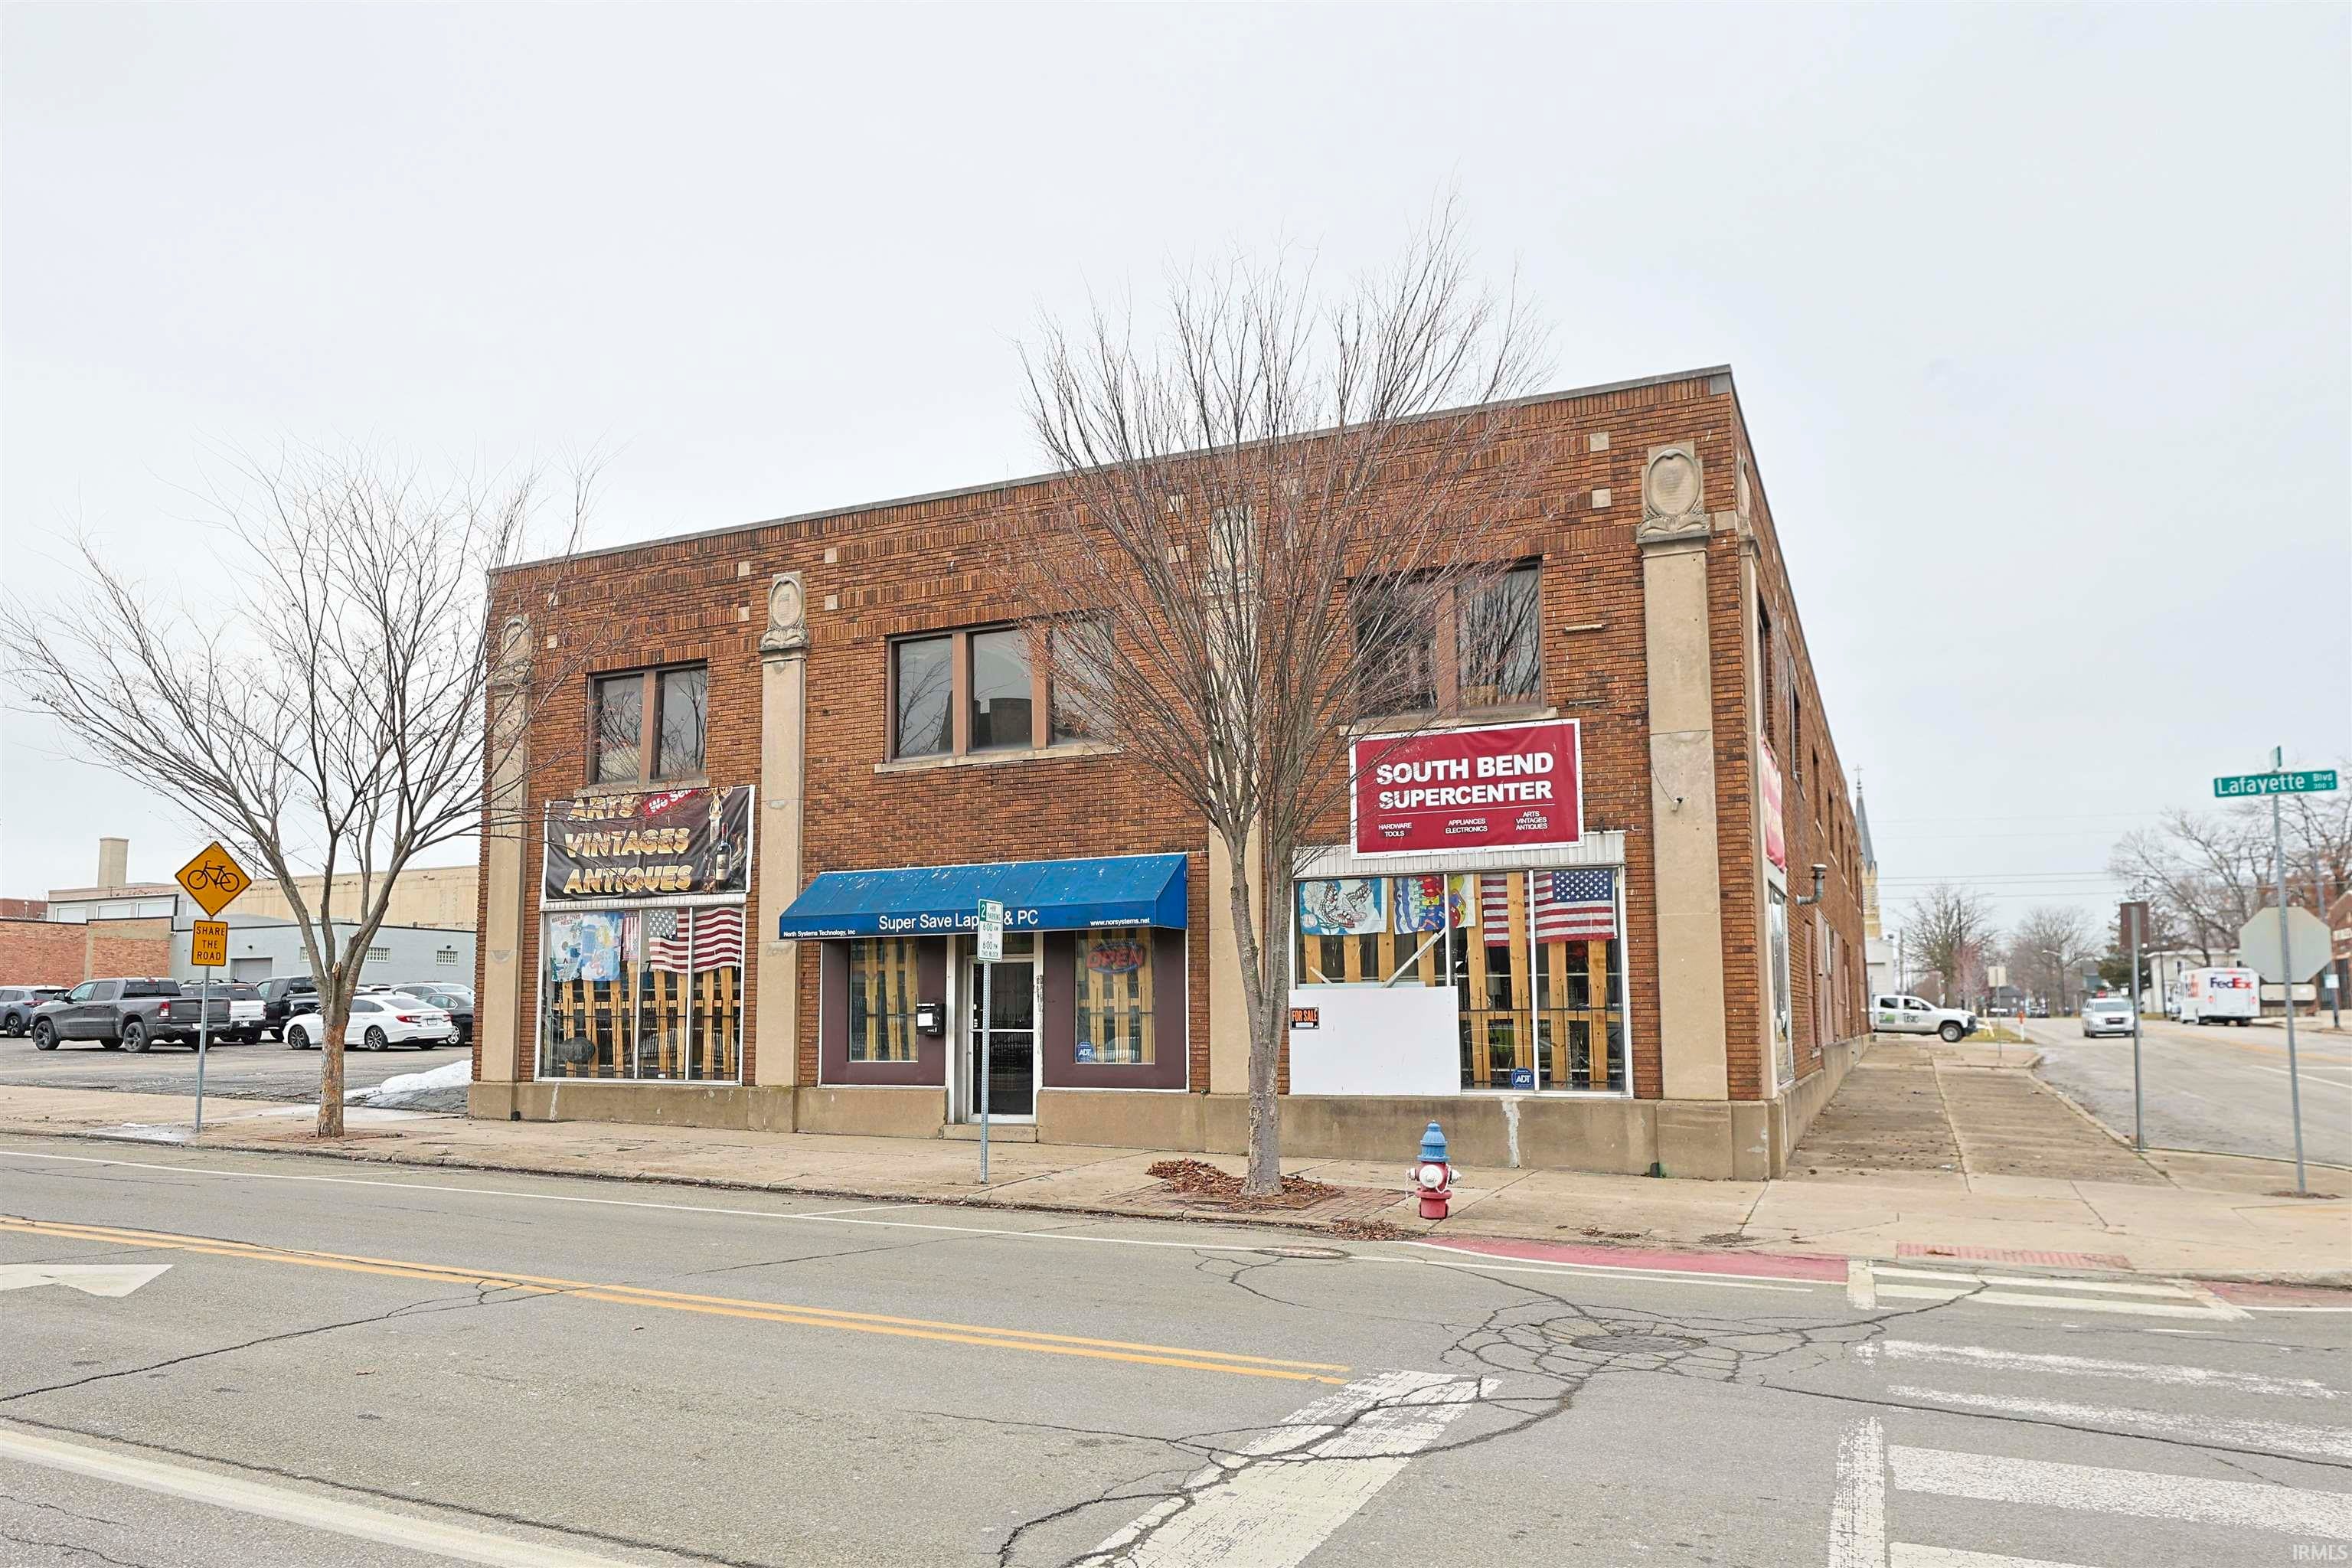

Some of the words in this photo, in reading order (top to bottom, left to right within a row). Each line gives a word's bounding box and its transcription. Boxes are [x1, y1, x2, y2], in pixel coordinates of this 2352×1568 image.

[1376, 758, 1468, 785] SOUTH
[1477, 752, 1553, 778] BEND
[2217, 774, 2305, 795] Lafayette
[2312, 773, 2333, 782] Blvd
[1379, 780, 1553, 809] SUPERCENTER
[648, 798, 668, 813] We
[1448, 818, 1486, 826] APPLIANCES
[1446, 825, 1488, 834] ELECTRONICS
[564, 828, 690, 858] VINTAGES
[564, 865, 693, 894] ANTIQUES
[981, 903, 986, 918] 2
[878, 915, 916, 932] Super
[920, 914, 952, 928] Save
[956, 913, 978, 929] Lap
[1004, 910, 1014, 926] &
[1018, 910, 1038, 925] PC
[1090, 917, 1150, 926] www.norsystems.net
[196, 926, 225, 936] SHARE
[202, 939, 218, 949] THE
[197, 951, 221, 960] ROAD
[1086, 947, 1144, 969] OPEN
[2210, 977, 2252, 988] FedEx
[1292, 1010, 1302, 1021] FOR
[1303, 1010, 1317, 1021] SALE
[1079, 1048, 1091, 1057] ADT
[1515, 1074, 1530, 1083] ADT
